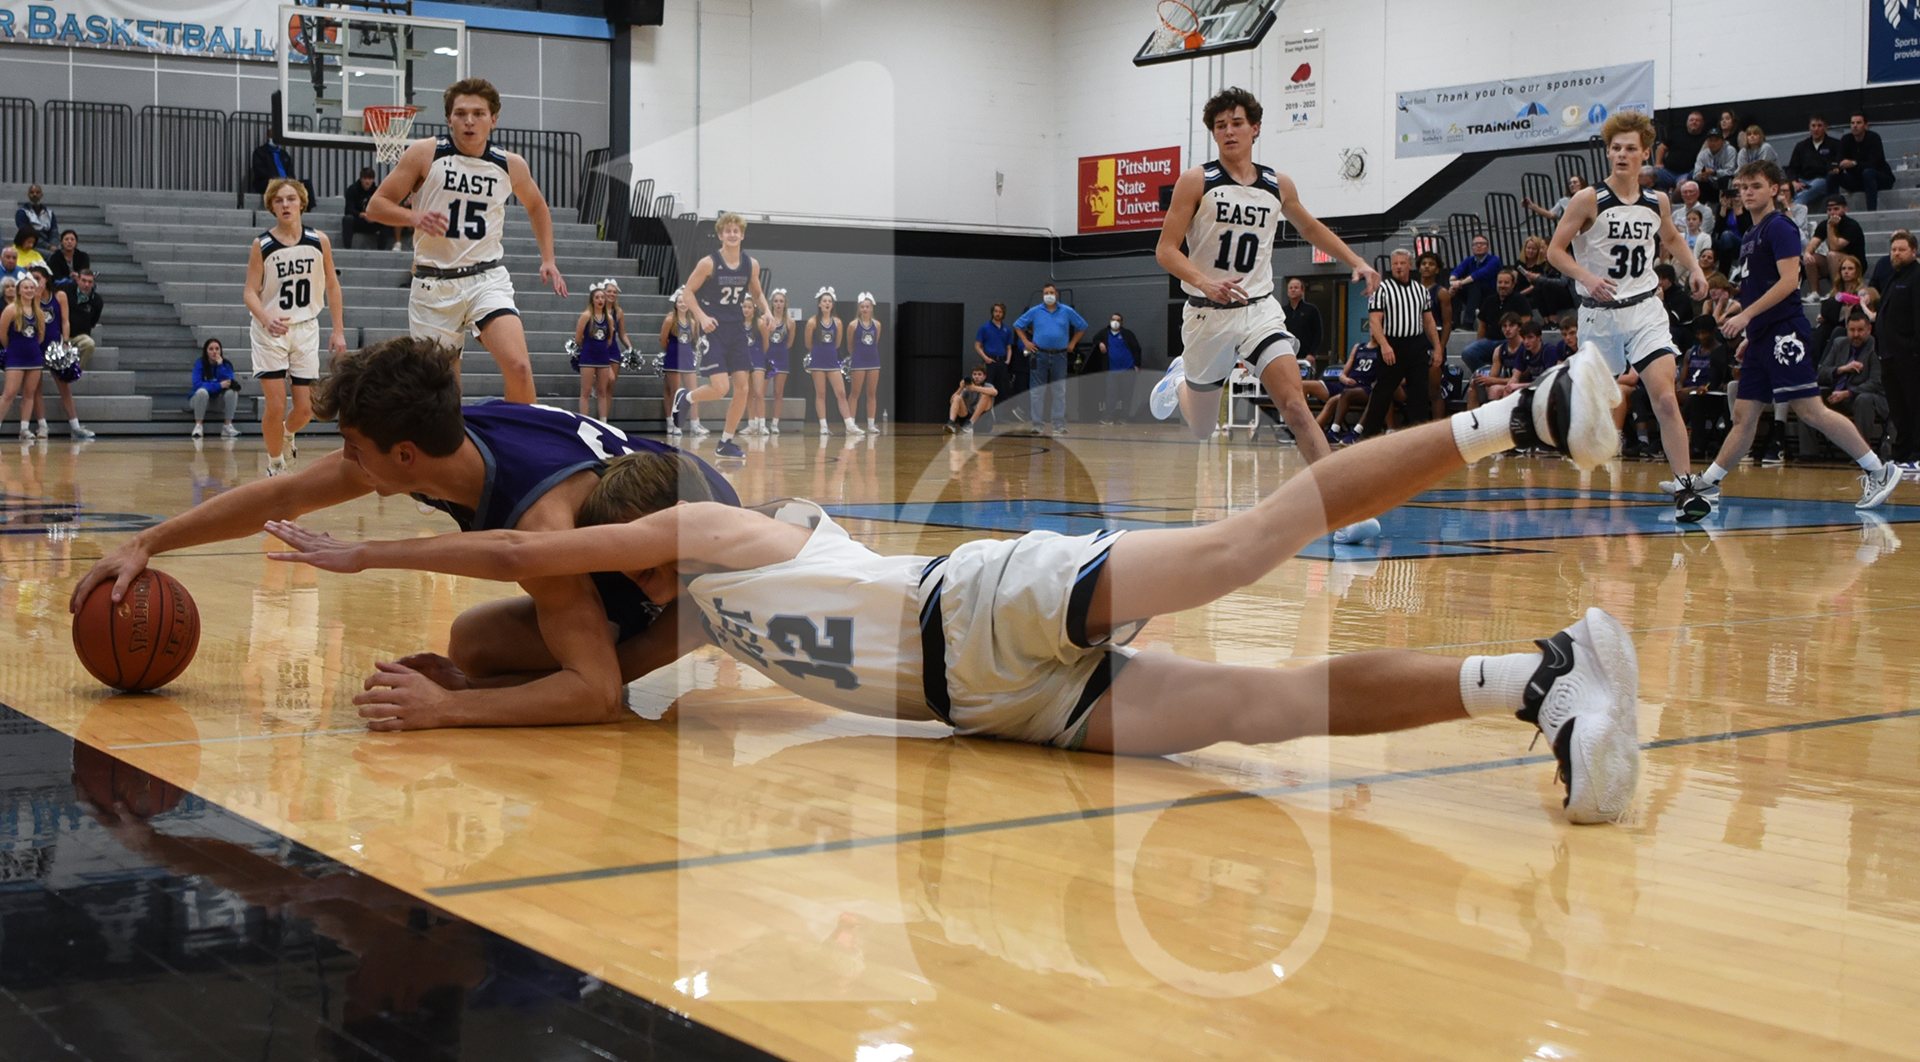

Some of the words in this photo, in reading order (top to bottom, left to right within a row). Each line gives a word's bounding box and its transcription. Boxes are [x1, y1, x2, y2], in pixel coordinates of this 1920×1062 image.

[1894, 38, 1918, 49] Sports
[1437, 91, 1470, 104] Thank
[1475, 88, 1496, 100] you
[1502, 86, 1514, 96] to
[1519, 83, 1540, 94] our
[1547, 75, 1605, 92] sponsors
[1117, 156, 1171, 176] Pittsburg
[443, 170, 498, 197] EAST
[1116, 179, 1146, 196] State
[445, 198, 488, 241] 15
[1215, 201, 1270, 228] EAST
[1608, 220, 1653, 241] EAST
[1214, 229, 1260, 274] 10
[1608, 245, 1648, 280] 30
[276, 257, 314, 279] EAST
[279, 279, 311, 311] 50
[720, 286, 744, 306] 25
[1355, 358, 1374, 372] 20
[766, 613, 862, 691] 12
